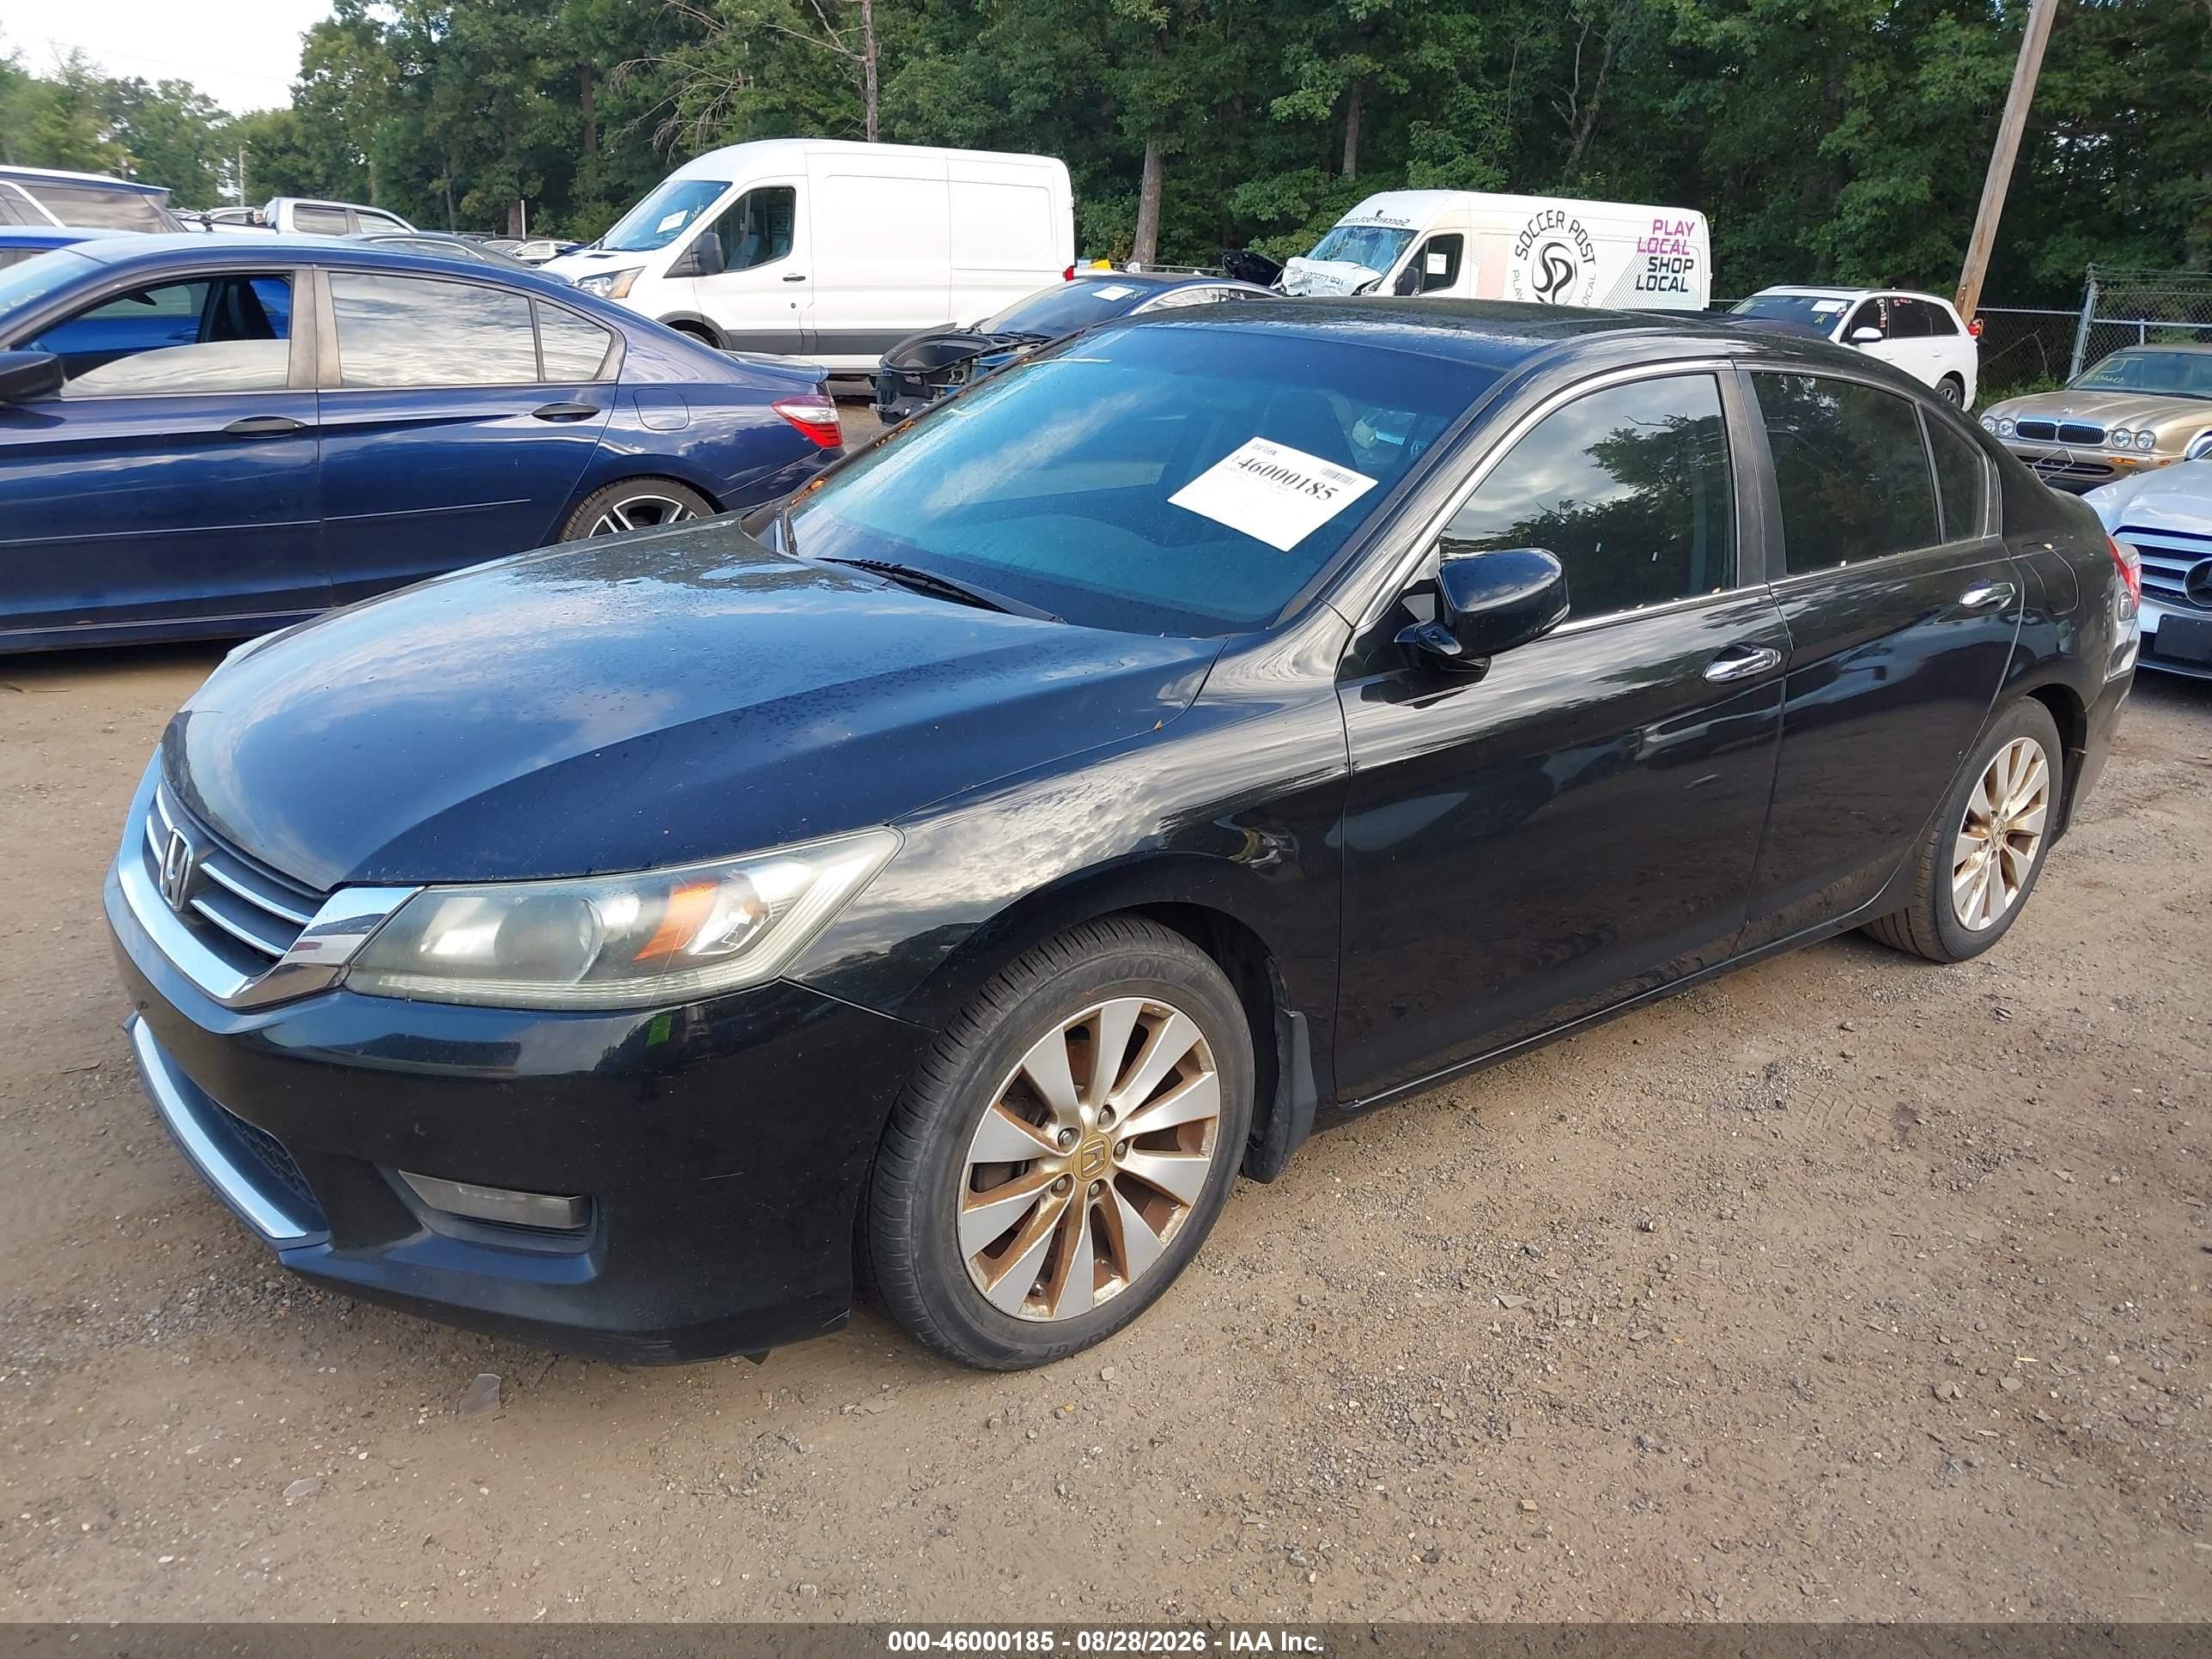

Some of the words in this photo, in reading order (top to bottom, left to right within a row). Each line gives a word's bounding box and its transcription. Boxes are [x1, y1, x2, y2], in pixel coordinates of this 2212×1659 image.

[1515, 210, 1565, 261] SOCCER
[1568, 219, 1596, 265] POST
[1652, 218, 1695, 237] PLAY
[1637, 236, 1691, 256] LOCAL
[1647, 256, 1694, 275] SHOP
[1581, 274, 1596, 307] OCAL
[1635, 274, 1689, 293] LOCAL
[1237, 456, 1340, 501] 46000185
